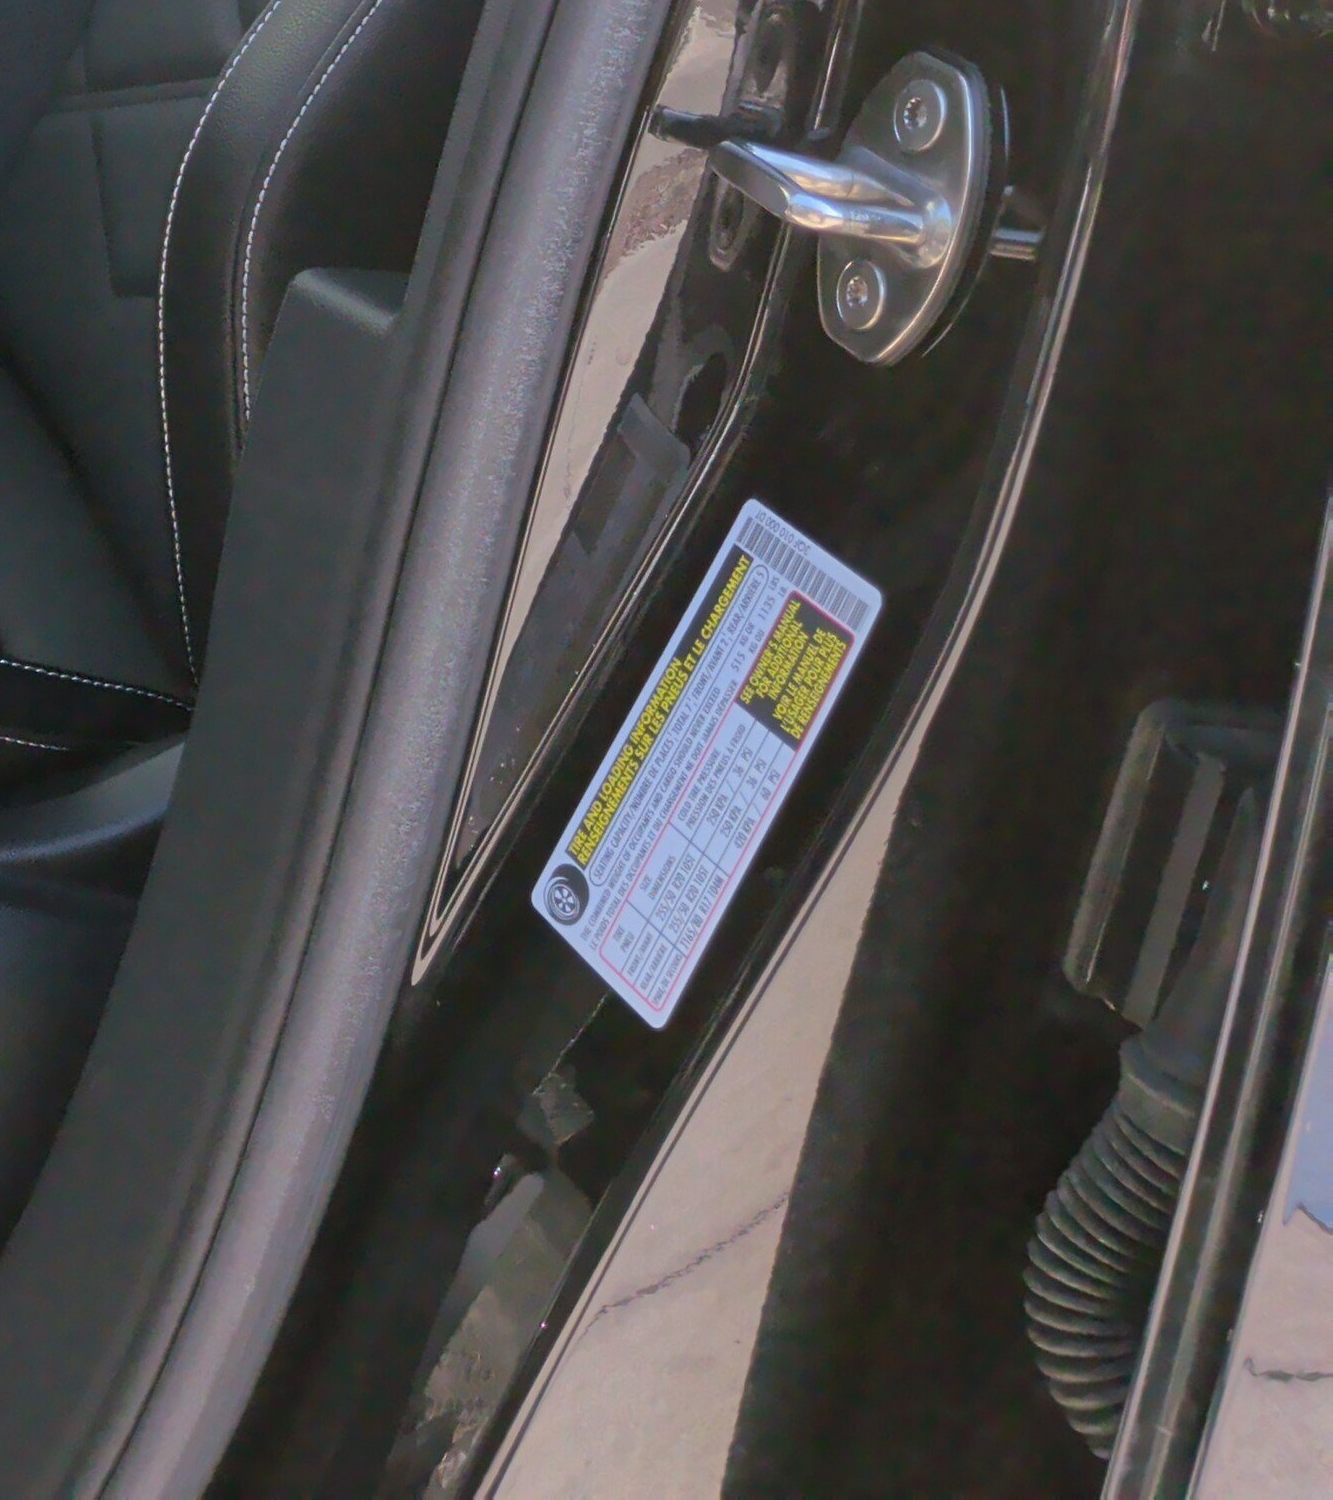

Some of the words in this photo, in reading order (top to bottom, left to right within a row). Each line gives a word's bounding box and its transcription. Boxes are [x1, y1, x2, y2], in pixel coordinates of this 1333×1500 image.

[757, 593, 776, 620] 1135
[738, 633, 749, 647] KG
[739, 682, 756, 705] SEE
[748, 639, 779, 688] OWNER'S
[771, 597, 801, 642] MANUAL
[746, 640, 758, 654] KG
[812, 627, 826, 644] DE
[729, 649, 746, 672] 515
[755, 675, 772, 699] FOR
[766, 617, 803, 678] ADDITIONAL
[767, 630, 809, 700] INFORMATION
[791, 641, 819, 685] MANUEL
[779, 683, 810, 732] L'USAGER
[803, 655, 824, 686] POUR
[818, 631, 837, 658] PLUS
[785, 681, 798, 696] LE
[796, 638, 847, 726] RENSEIGNEMENTS
[576, 757, 640, 866] RENSEIGNEMENTS
[633, 731, 654, 761] SUR
[647, 710, 666, 735] LES
[659, 668, 689, 713] PNEUS
[682, 652, 697, 671] ET
[690, 638, 705, 656] LE
[699, 554, 751, 641] CHARGEMENT
[671, 710, 689, 735] TOTAL
[772, 693, 792, 722] VOIR
[789, 721, 804, 739] DE
[567, 827, 587, 857] TIRE
[581, 798, 603, 831] AND
[597, 742, 634, 801] LOADING
[629, 656, 682, 745] INFORMATION
[653, 736, 674, 768] PLACES
[683, 758, 694, 773] NE
[731, 762, 744, 777] 36
[739, 745, 753, 762] PSI
[622, 849, 632, 863] OF
[628, 808, 654, 852] OCCUPANTS
[650, 791, 664, 810] AND
[659, 765, 677, 793] CARGO
[673, 736, 693, 768] SHOULD
[689, 712, 706, 738] NEVER
[702, 685, 720, 714] EXCEED
[647, 762, 660, 779] DE
[745, 773, 757, 789] 36
[752, 756, 767, 774] PSI
[766, 766, 780, 785] PSI
[592, 845, 615, 881] SEATING
